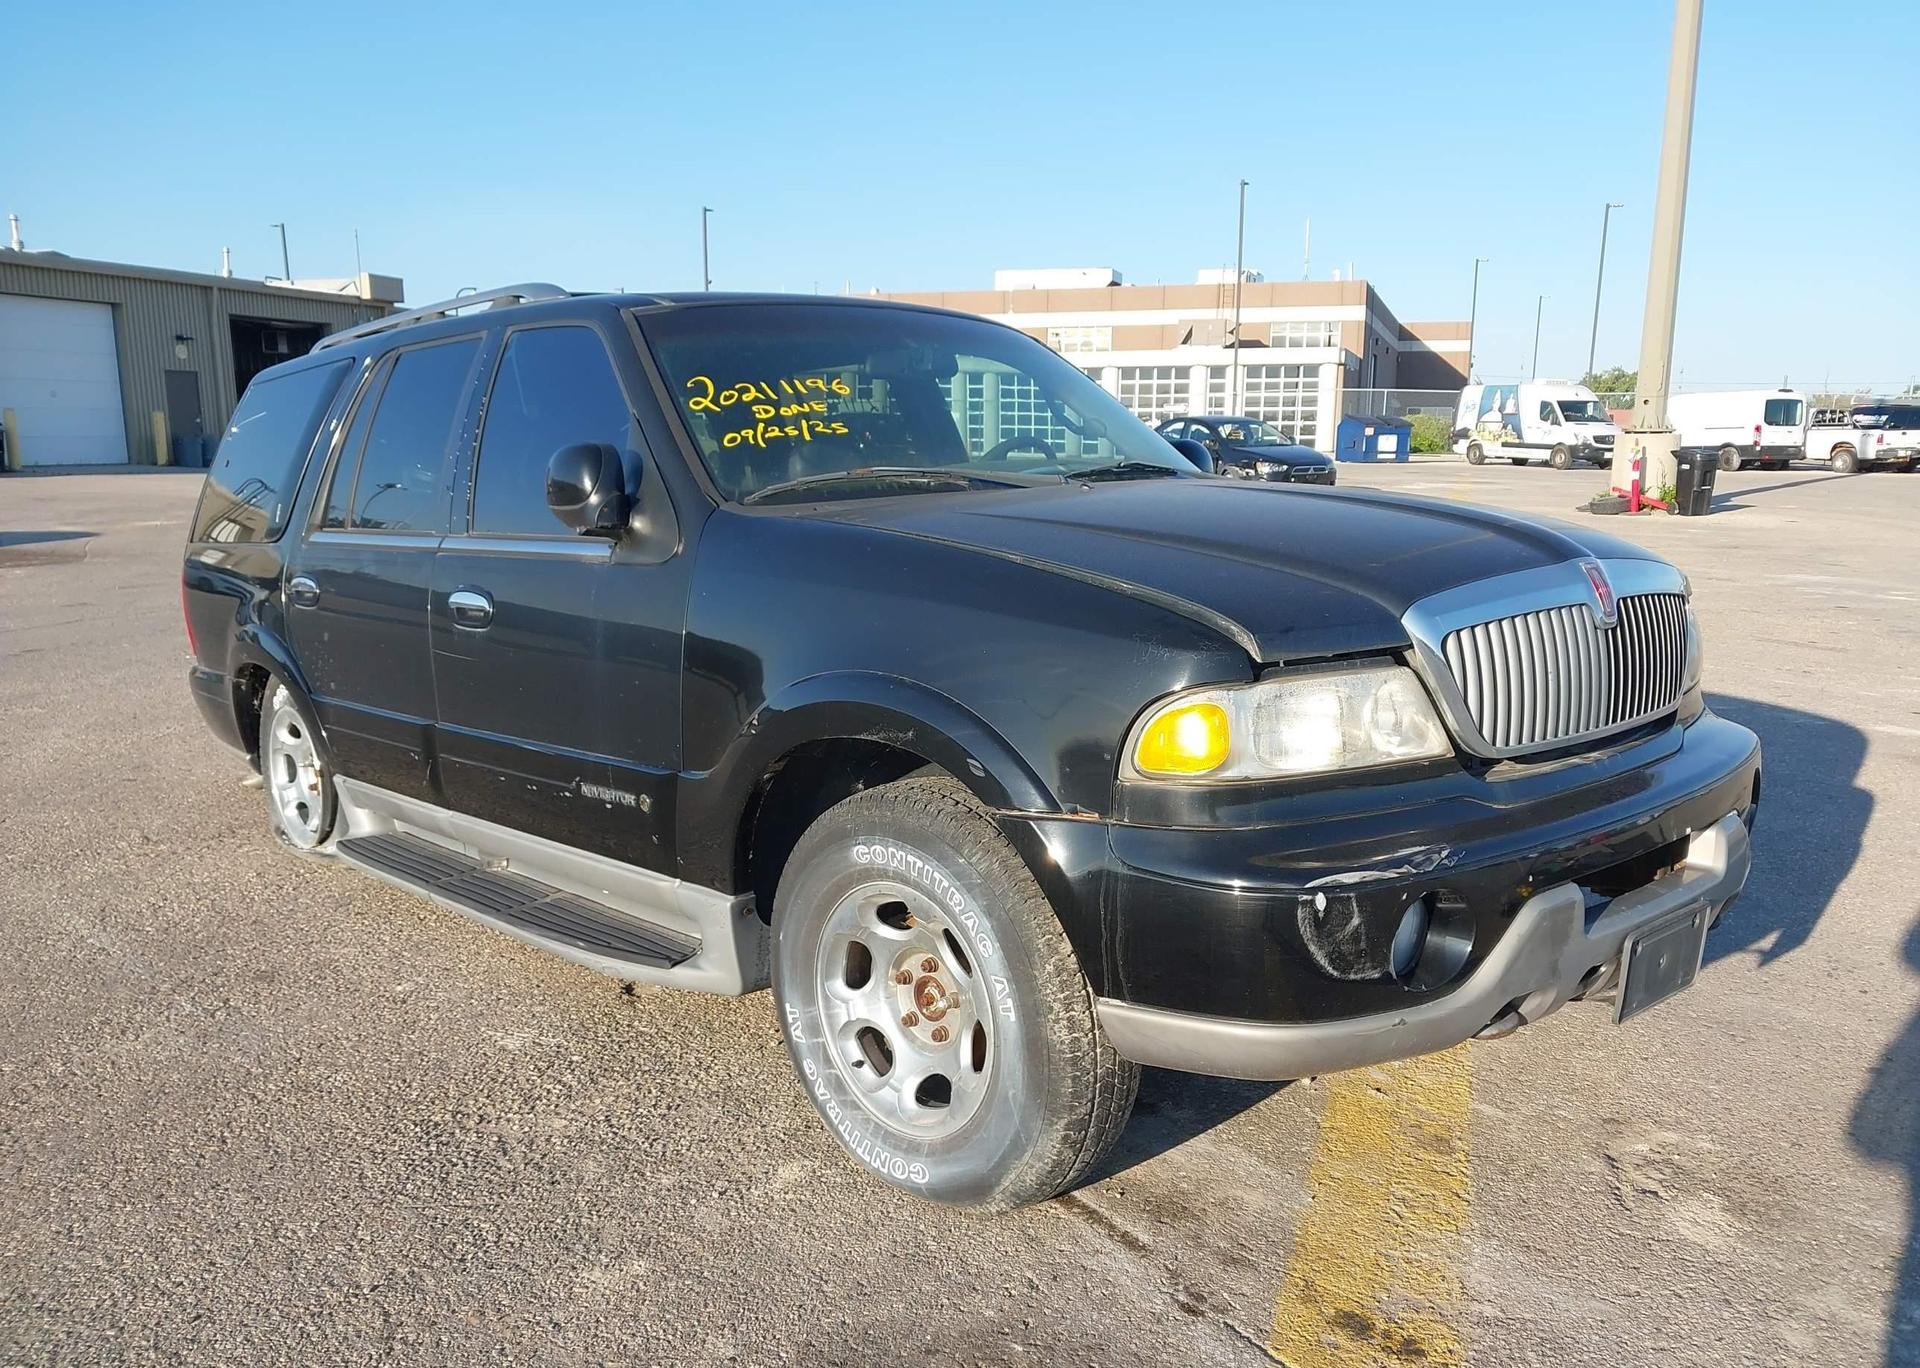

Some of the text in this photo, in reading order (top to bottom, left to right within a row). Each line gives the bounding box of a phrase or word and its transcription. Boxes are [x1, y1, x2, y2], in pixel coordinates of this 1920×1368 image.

[687, 376, 850, 411] 20211196
[752, 401, 828, 419] DONE
[723, 420, 849, 448] 09/25/25
[581, 783, 637, 807] NAVIGATOR
[853, 844, 1016, 1022] CONTITRAC AT
[785, 1002, 930, 1184] CONTITRAC AT
